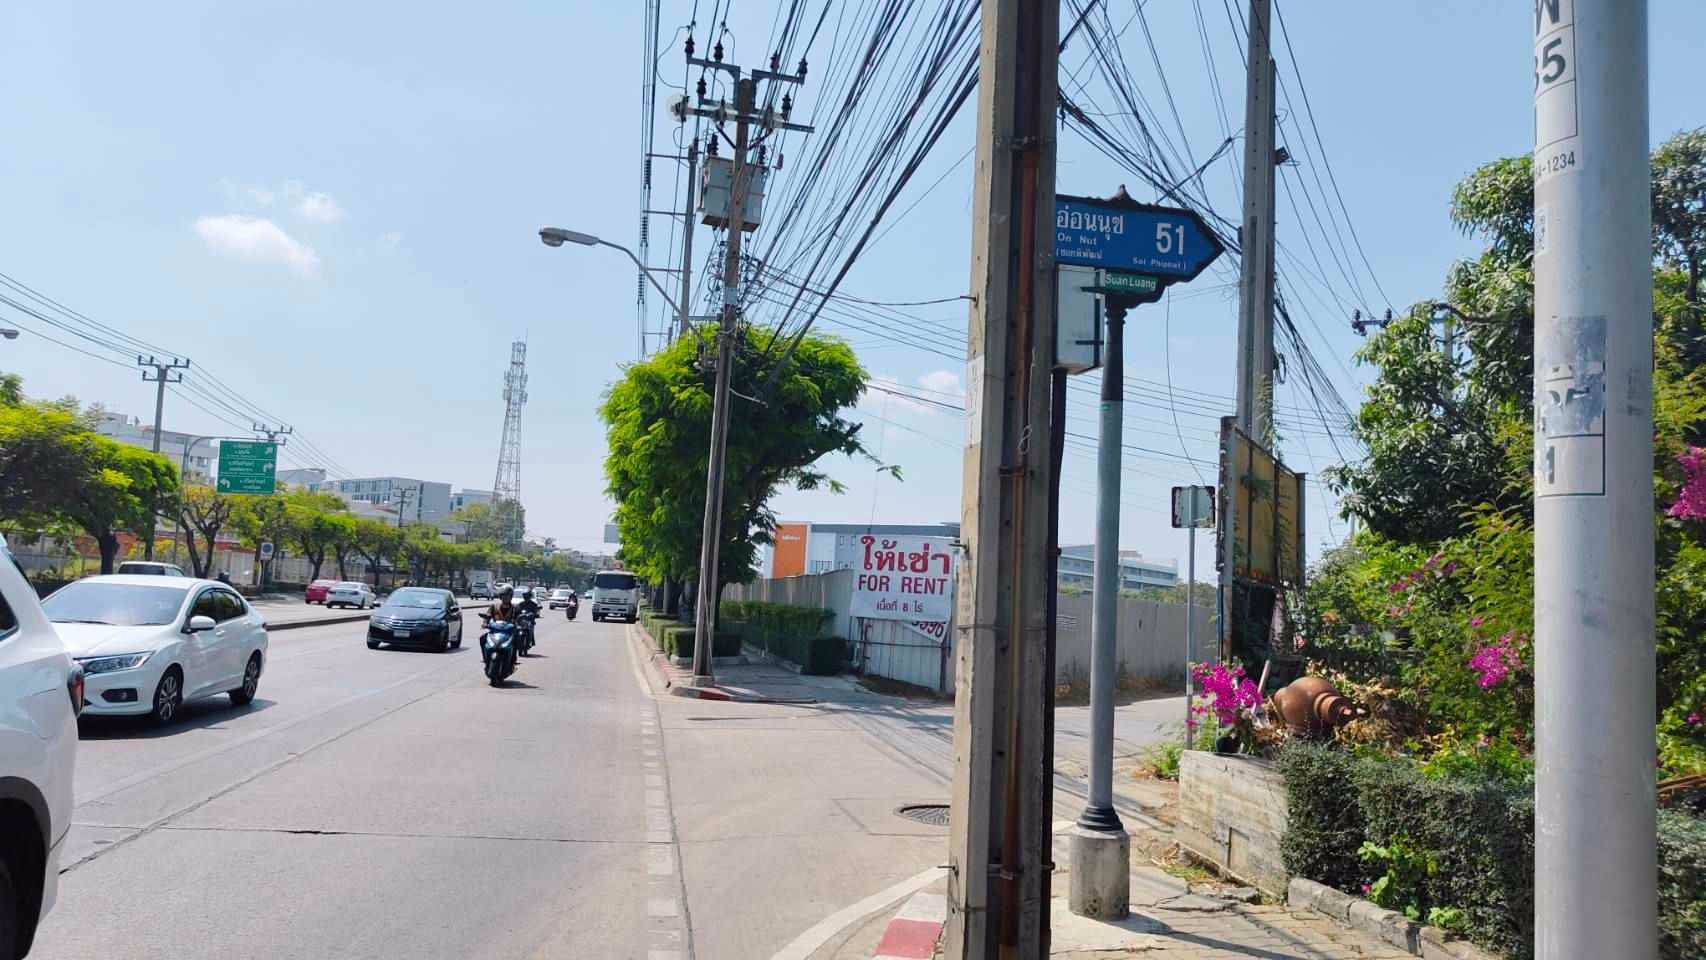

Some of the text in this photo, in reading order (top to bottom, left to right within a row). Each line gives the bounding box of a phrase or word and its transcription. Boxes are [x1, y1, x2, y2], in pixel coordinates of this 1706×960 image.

[1056, 204, 1185, 255] อ่อนนุช 51
[1057, 232, 1097, 245] On Nut
[1105, 273, 1156, 291] Suan Luang
[860, 535, 950, 575] ให้เช่า
[858, 574, 948, 595] FOR RENT
